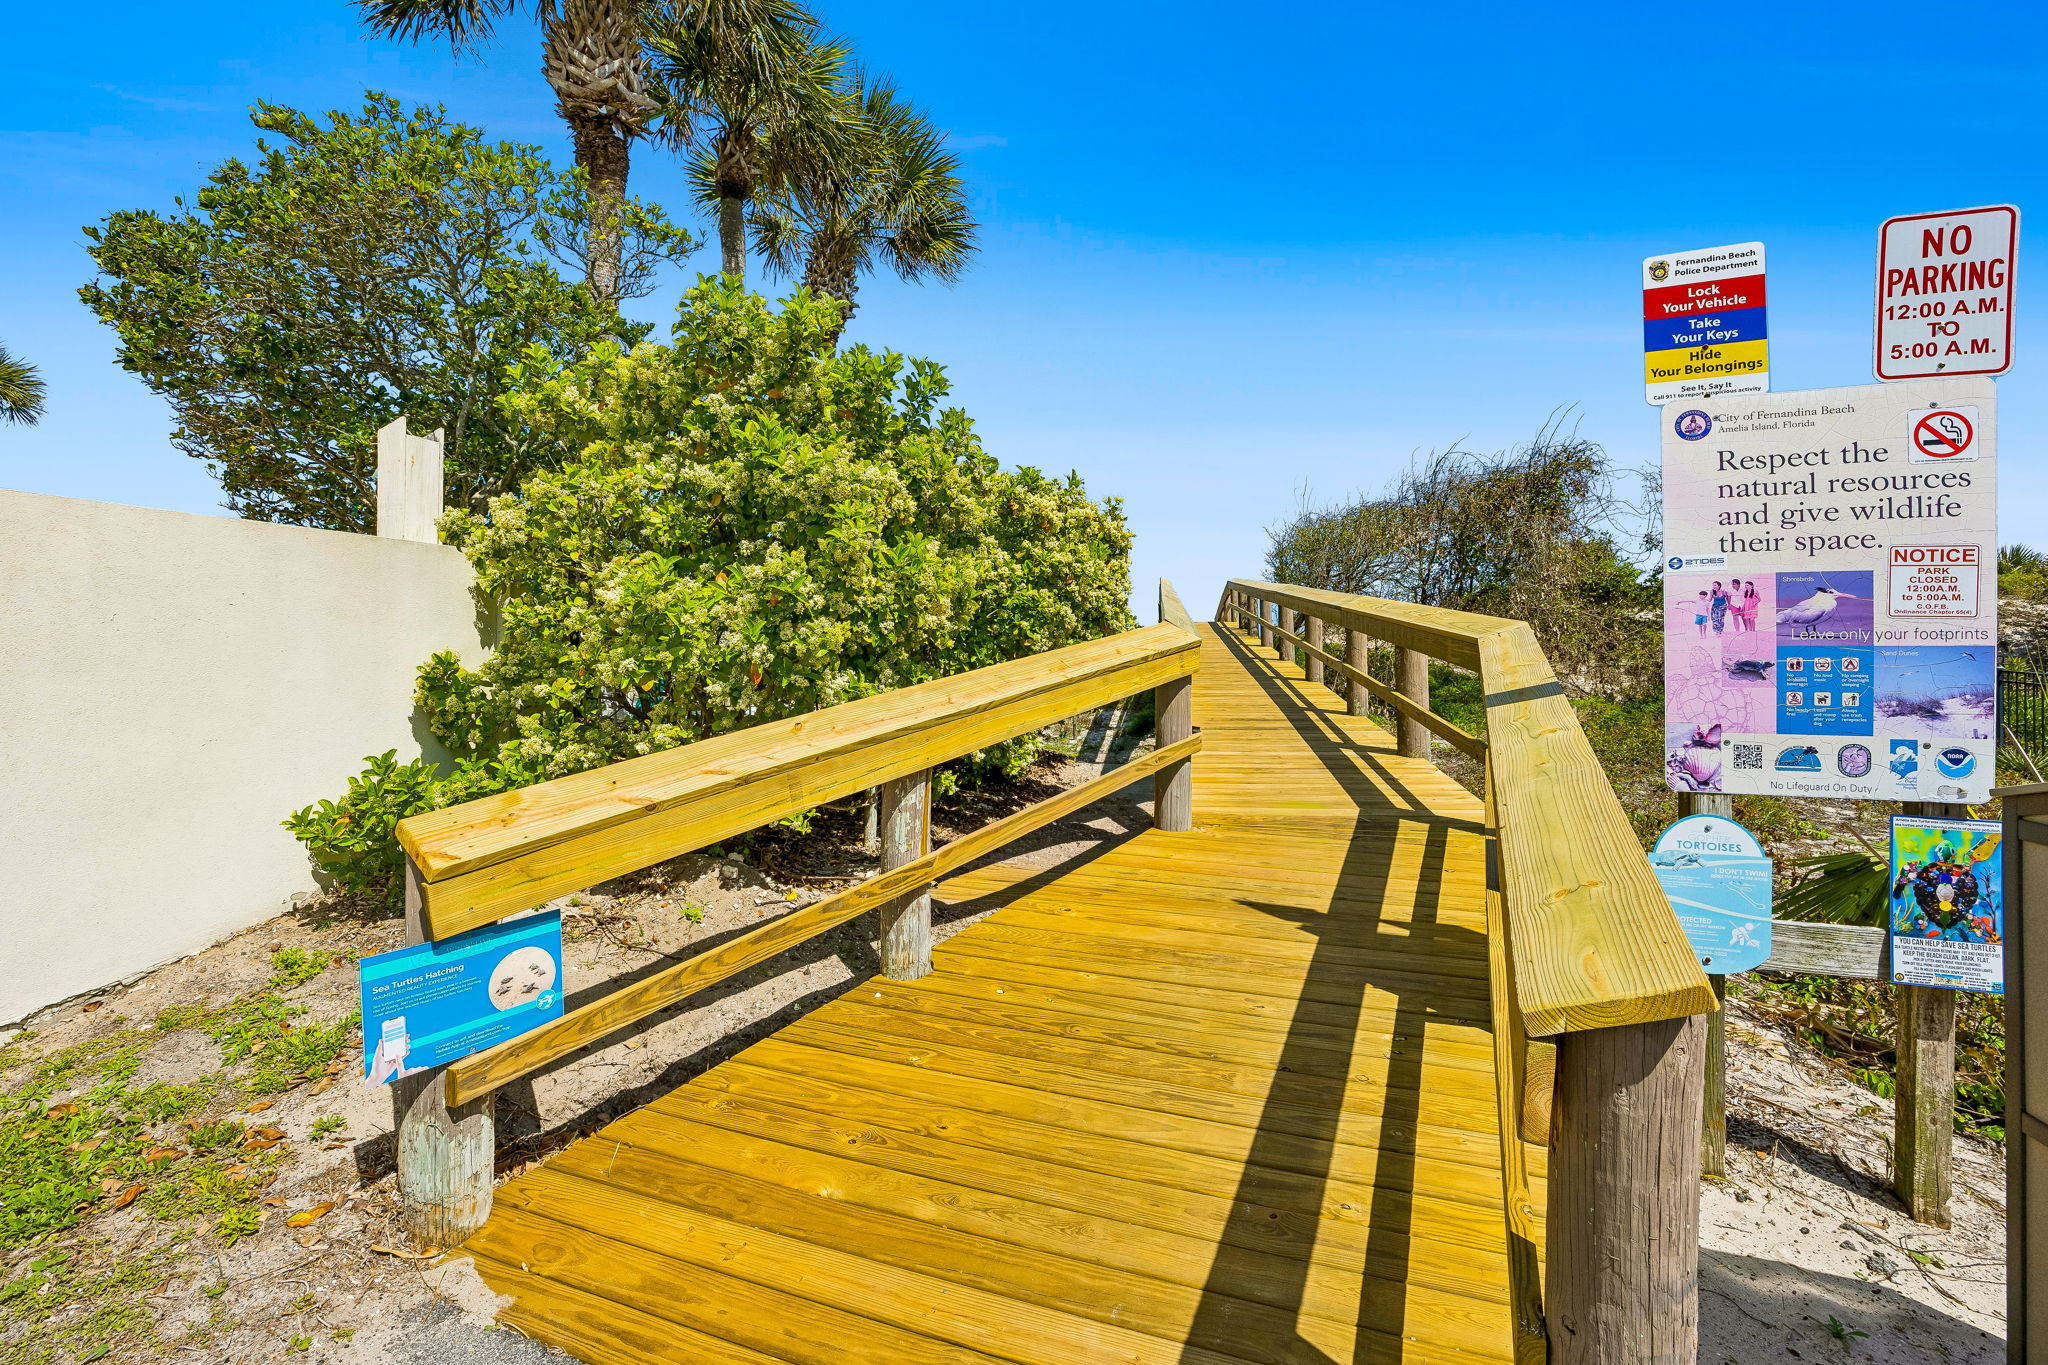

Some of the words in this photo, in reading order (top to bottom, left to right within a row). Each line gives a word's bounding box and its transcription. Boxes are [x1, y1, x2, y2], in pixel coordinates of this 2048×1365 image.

[1922, 225, 1972, 258] NO
[1676, 253, 1726, 266] Fernandina
[1729, 250, 1756, 258] Beach
[1674, 268, 1701, 276] Police
[1703, 260, 1758, 272] Department
[1887, 258, 2005, 297] PARKING
[1688, 285, 1720, 298] Lock
[1663, 302, 1694, 313] Your
[1696, 294, 1746, 309] Vehicle
[1886, 302, 1945, 320] 12:00
[1952, 297, 2004, 315] A.M.
[1689, 318, 1720, 329] Take
[1927, 321, 1960, 337] TO
[1672, 333, 1703, 343] Your
[1706, 329, 1738, 341] Keys
[1690, 350, 1721, 361] Hide
[1891, 342, 1937, 359] 5:00
[1944, 338, 1996, 356] A.M.
[1651, 368, 1681, 377] Your
[1685, 360, 1763, 374] Belongings
[1718, 414, 1739, 423] City
[1743, 412, 1755, 421] of
[1757, 408, 1817, 420] Fernandina
[1821, 404, 1855, 414] Beach
[1718, 425, 1749, 433] Amelia
[1752, 423, 1780, 431] Island,
[1783, 420, 1815, 428] Florida
[1716, 448, 1830, 474] Respect
[1841, 441, 1888, 464] the
[1718, 472, 1817, 498] natural
[1828, 471, 1971, 493] resources
[1719, 503, 1769, 526] and
[1780, 502, 1839, 529] give
[1850, 494, 1962, 521] wildlife
[1719, 531, 1784, 554] their
[1795, 533, 1882, 556] space.
[1894, 549, 1975, 562] NOTICE
[1791, 629, 1835, 641] Leave
[1840, 628, 1871, 642] only
[1875, 630, 1909, 642] your
[1914, 627, 1989, 642] footprints
[1787, 782, 1829, 792] Lifeguard
[1850, 784, 1872, 794] Duty
[1677, 840, 1742, 852] TORTOISES
[1970, 944, 1996, 952] TURTLES
[372, 985, 390, 994] Sea
[392, 976, 423, 988] Turtles
[426, 964, 464, 979] Hatching
[373, 988, 406, 1001] AUGMENTED
[407, 982, 427, 991] REALITY
